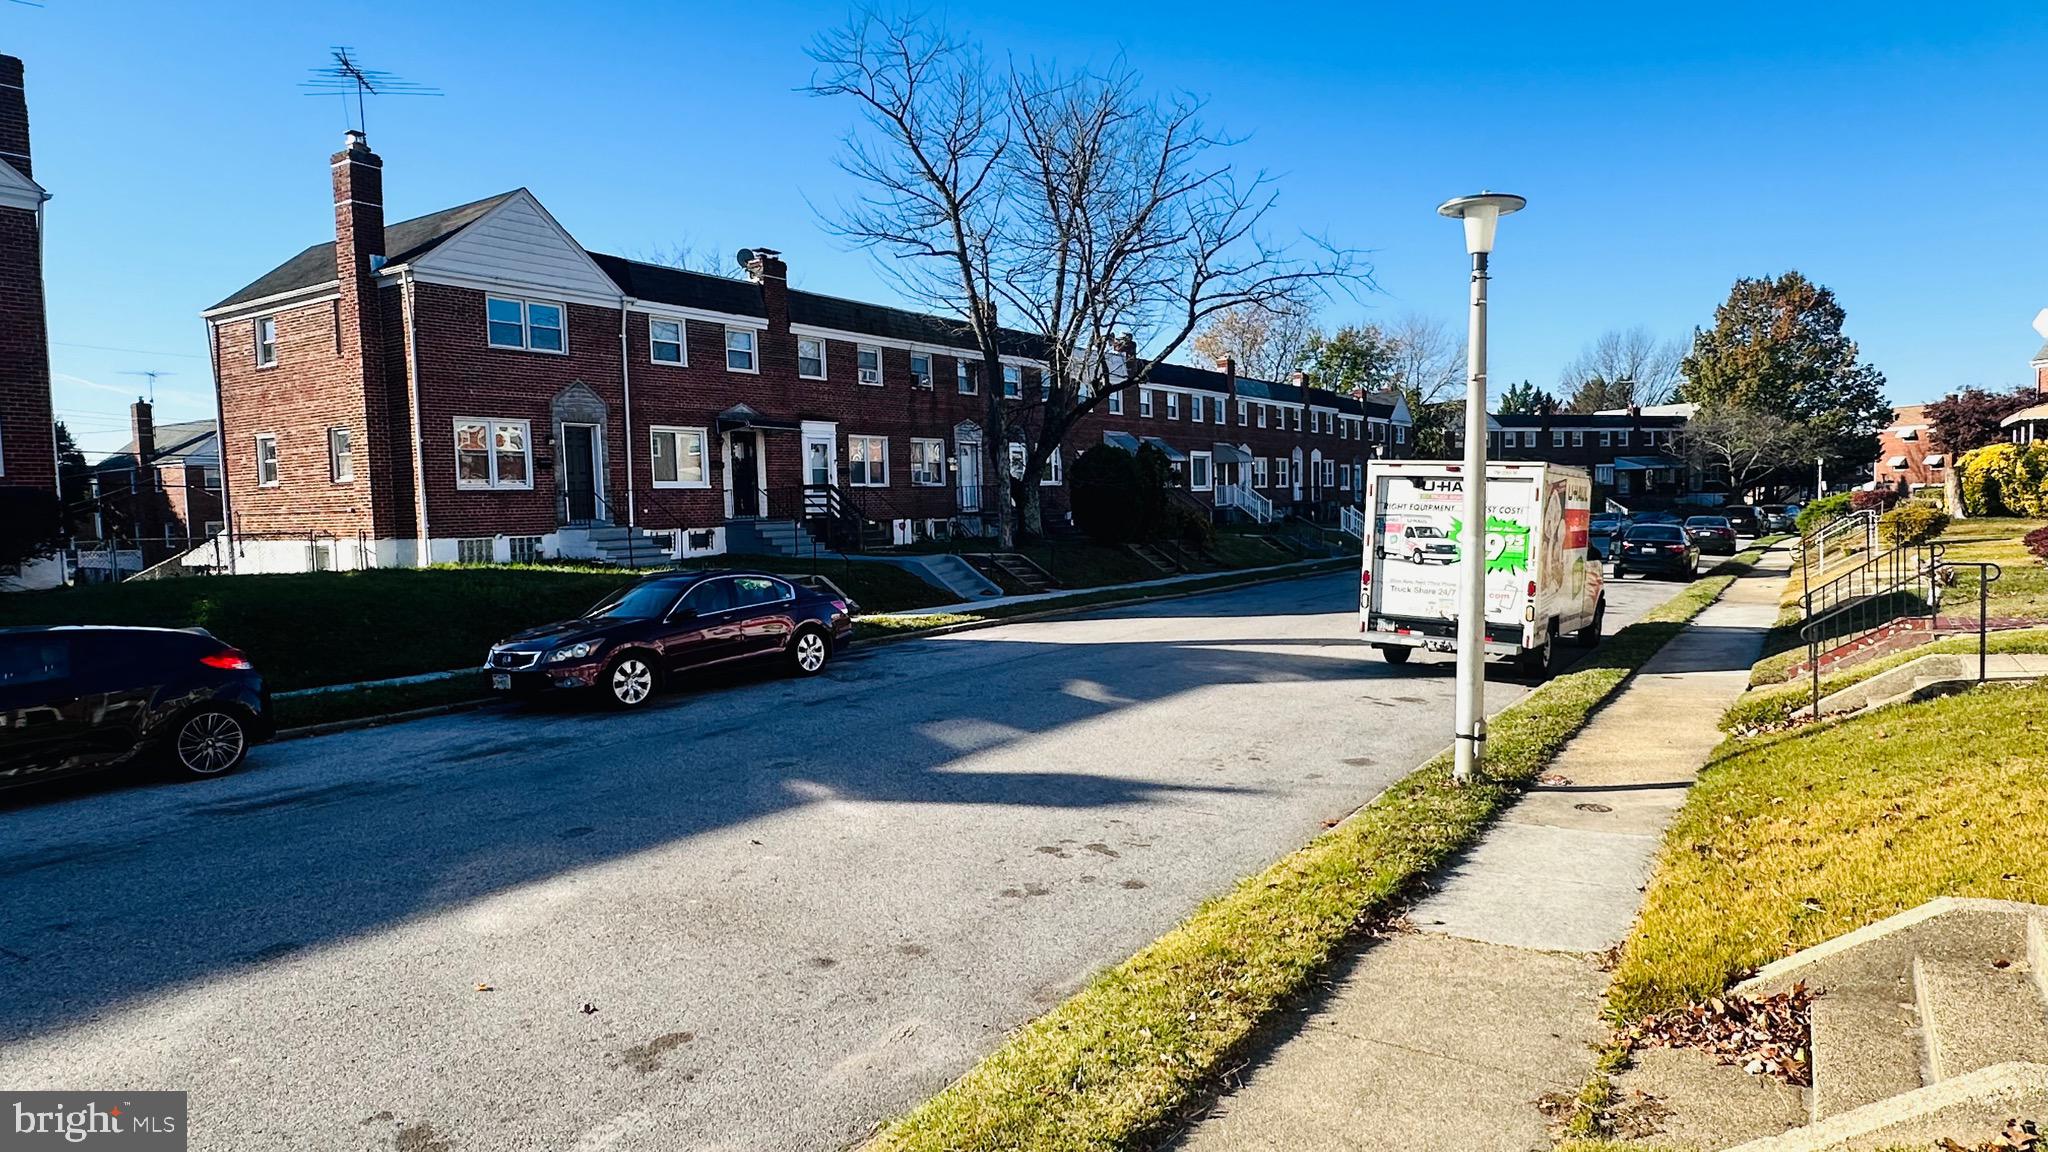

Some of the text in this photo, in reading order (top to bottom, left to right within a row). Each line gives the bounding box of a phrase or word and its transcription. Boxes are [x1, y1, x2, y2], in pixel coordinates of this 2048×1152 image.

[1422, 481, 1463, 492] U-HA
[1384, 502, 1407, 510] RIGHT
[1409, 503, 1455, 512] EQUIPMENT
[1390, 584, 1457, 597] Truck Share 24/7
[1488, 592, 1510, 600] com
